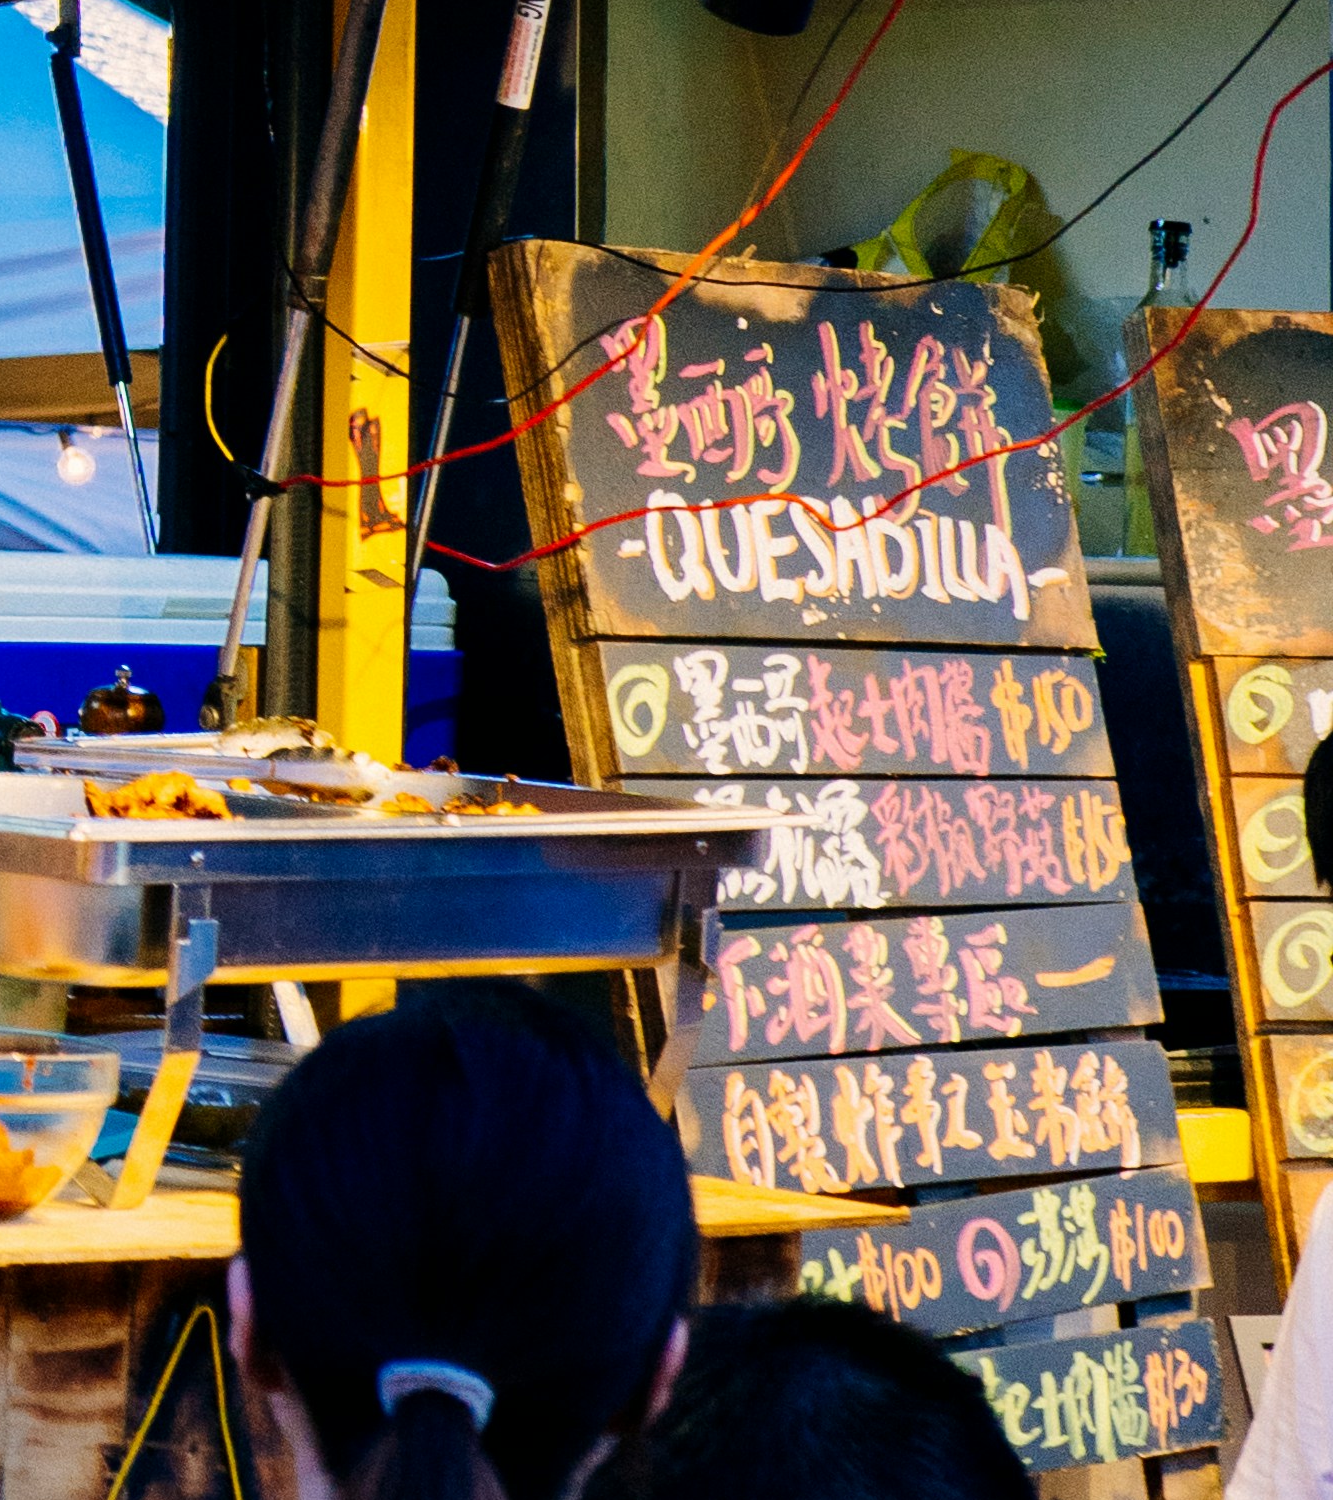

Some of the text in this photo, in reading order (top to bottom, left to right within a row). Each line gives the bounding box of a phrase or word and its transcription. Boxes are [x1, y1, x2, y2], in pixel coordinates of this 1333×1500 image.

[599, 314, 799, 494] 墨西哥
[1107, 1199, 1185, 1292] $100
